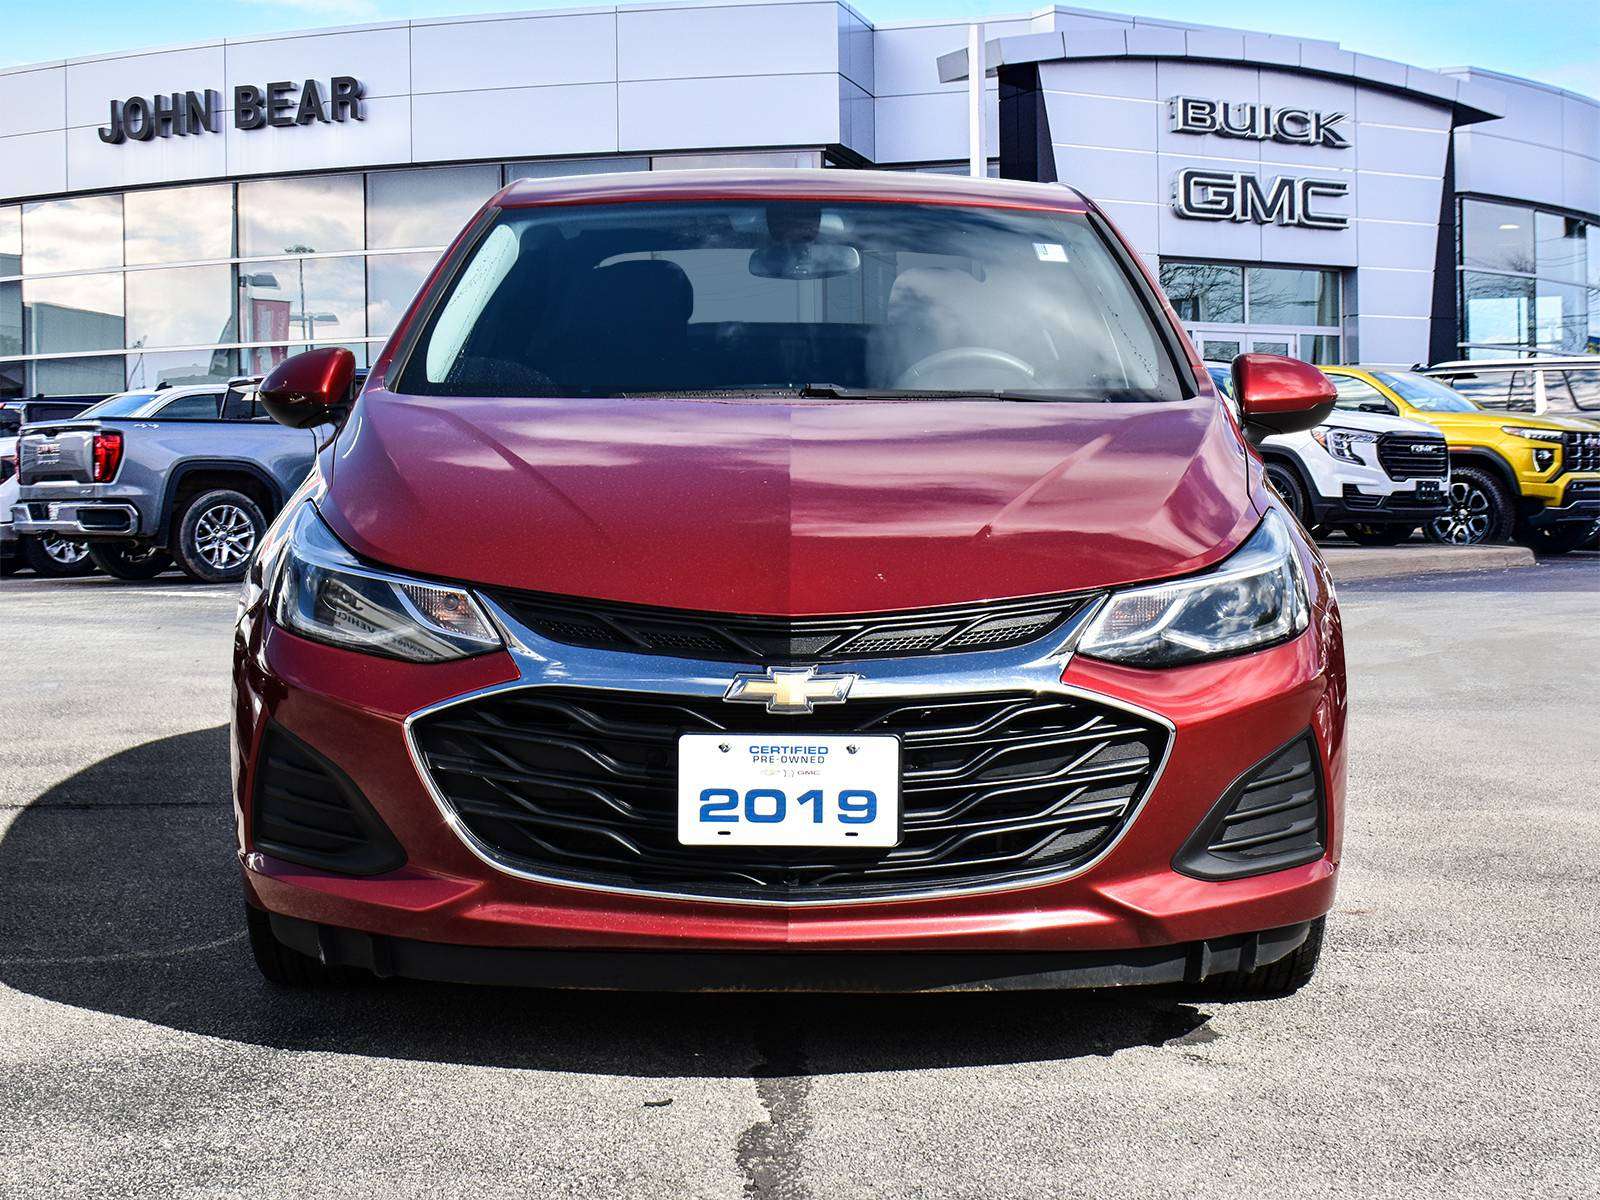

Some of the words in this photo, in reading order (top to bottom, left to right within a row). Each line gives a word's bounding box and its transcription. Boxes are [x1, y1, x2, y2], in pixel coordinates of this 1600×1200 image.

[98, 89, 220, 144] JOHN
[234, 75, 366, 130] BEAR
[1171, 96, 1352, 148] BUICK
[1173, 167, 1350, 230] GMC
[749, 745, 829, 755] CERTIFIED
[752, 755, 825, 764] PRE-OWNED
[699, 788, 877, 824] 2019
